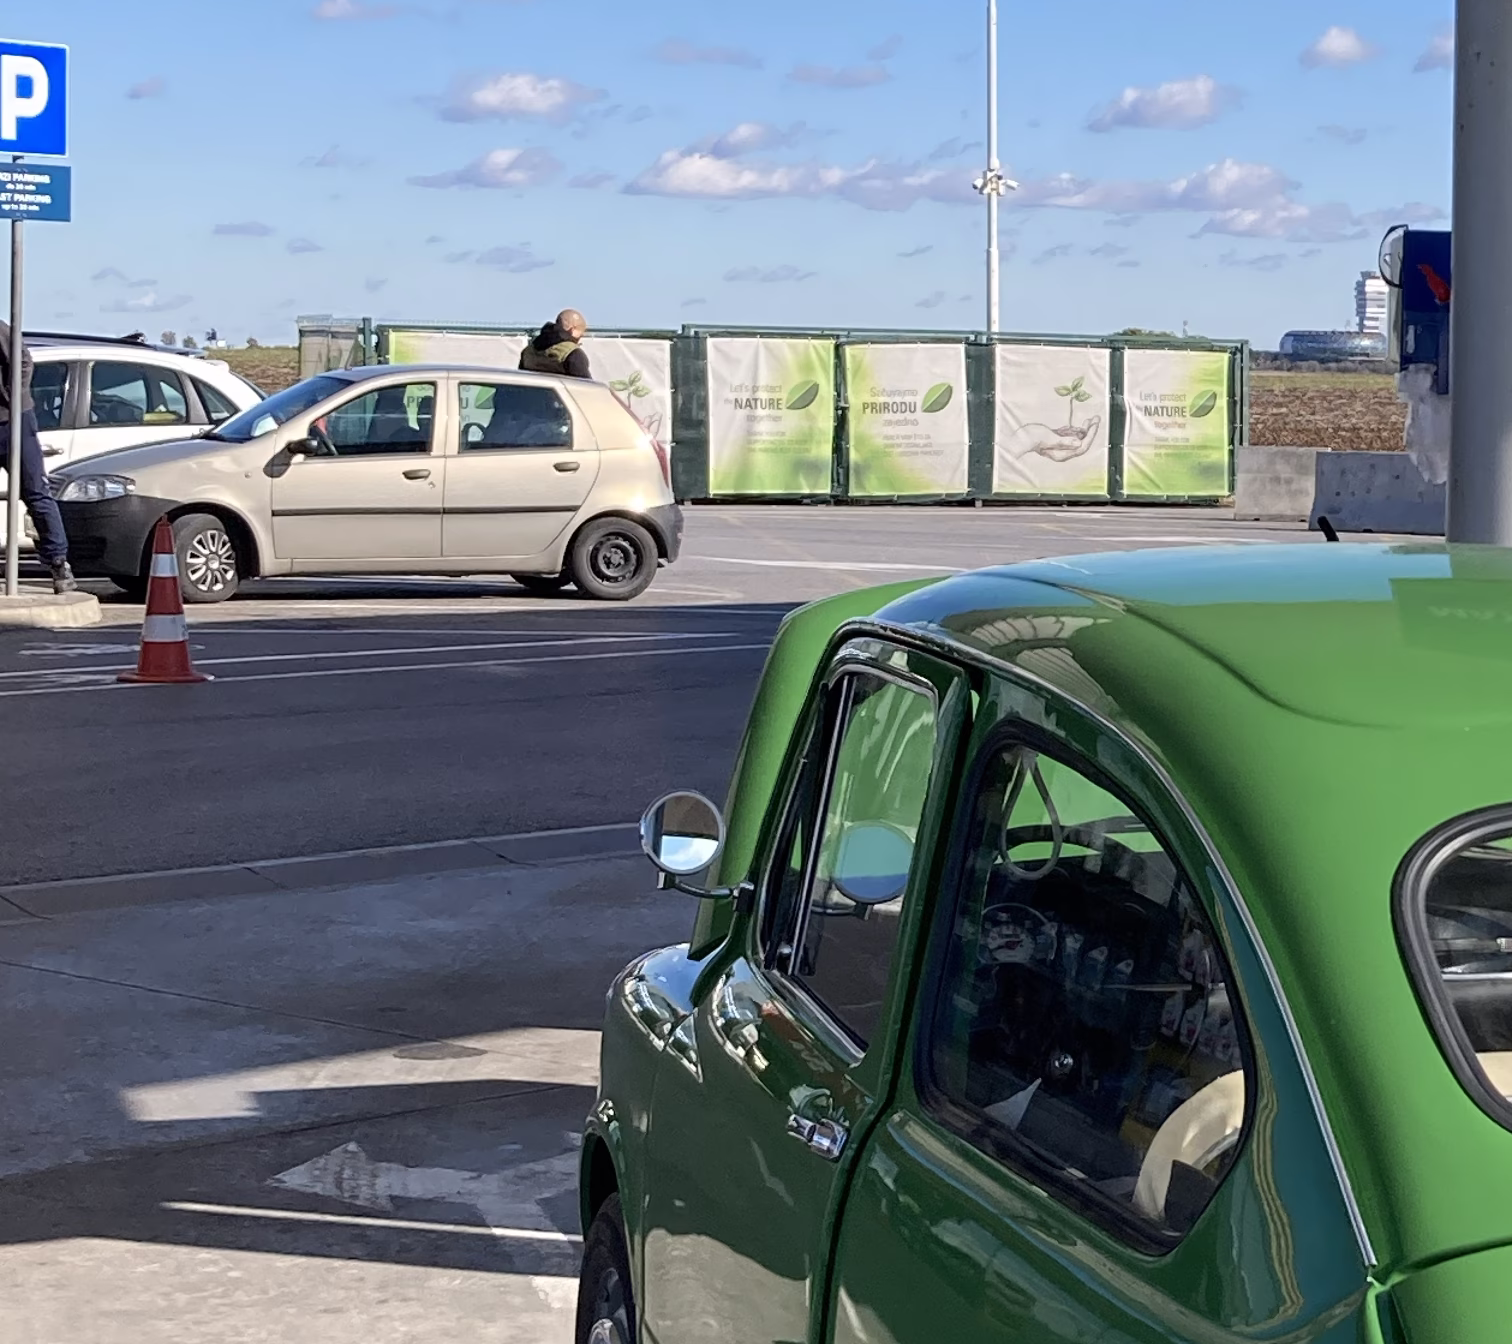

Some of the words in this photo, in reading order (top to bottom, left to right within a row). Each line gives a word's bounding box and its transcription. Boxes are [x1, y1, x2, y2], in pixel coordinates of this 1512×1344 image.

[1, 54, 50, 140] P
[734, 397, 784, 411] NATURE
[861, 401, 918, 415] PRIRODU
[1143, 404, 1188, 418] NATURE
